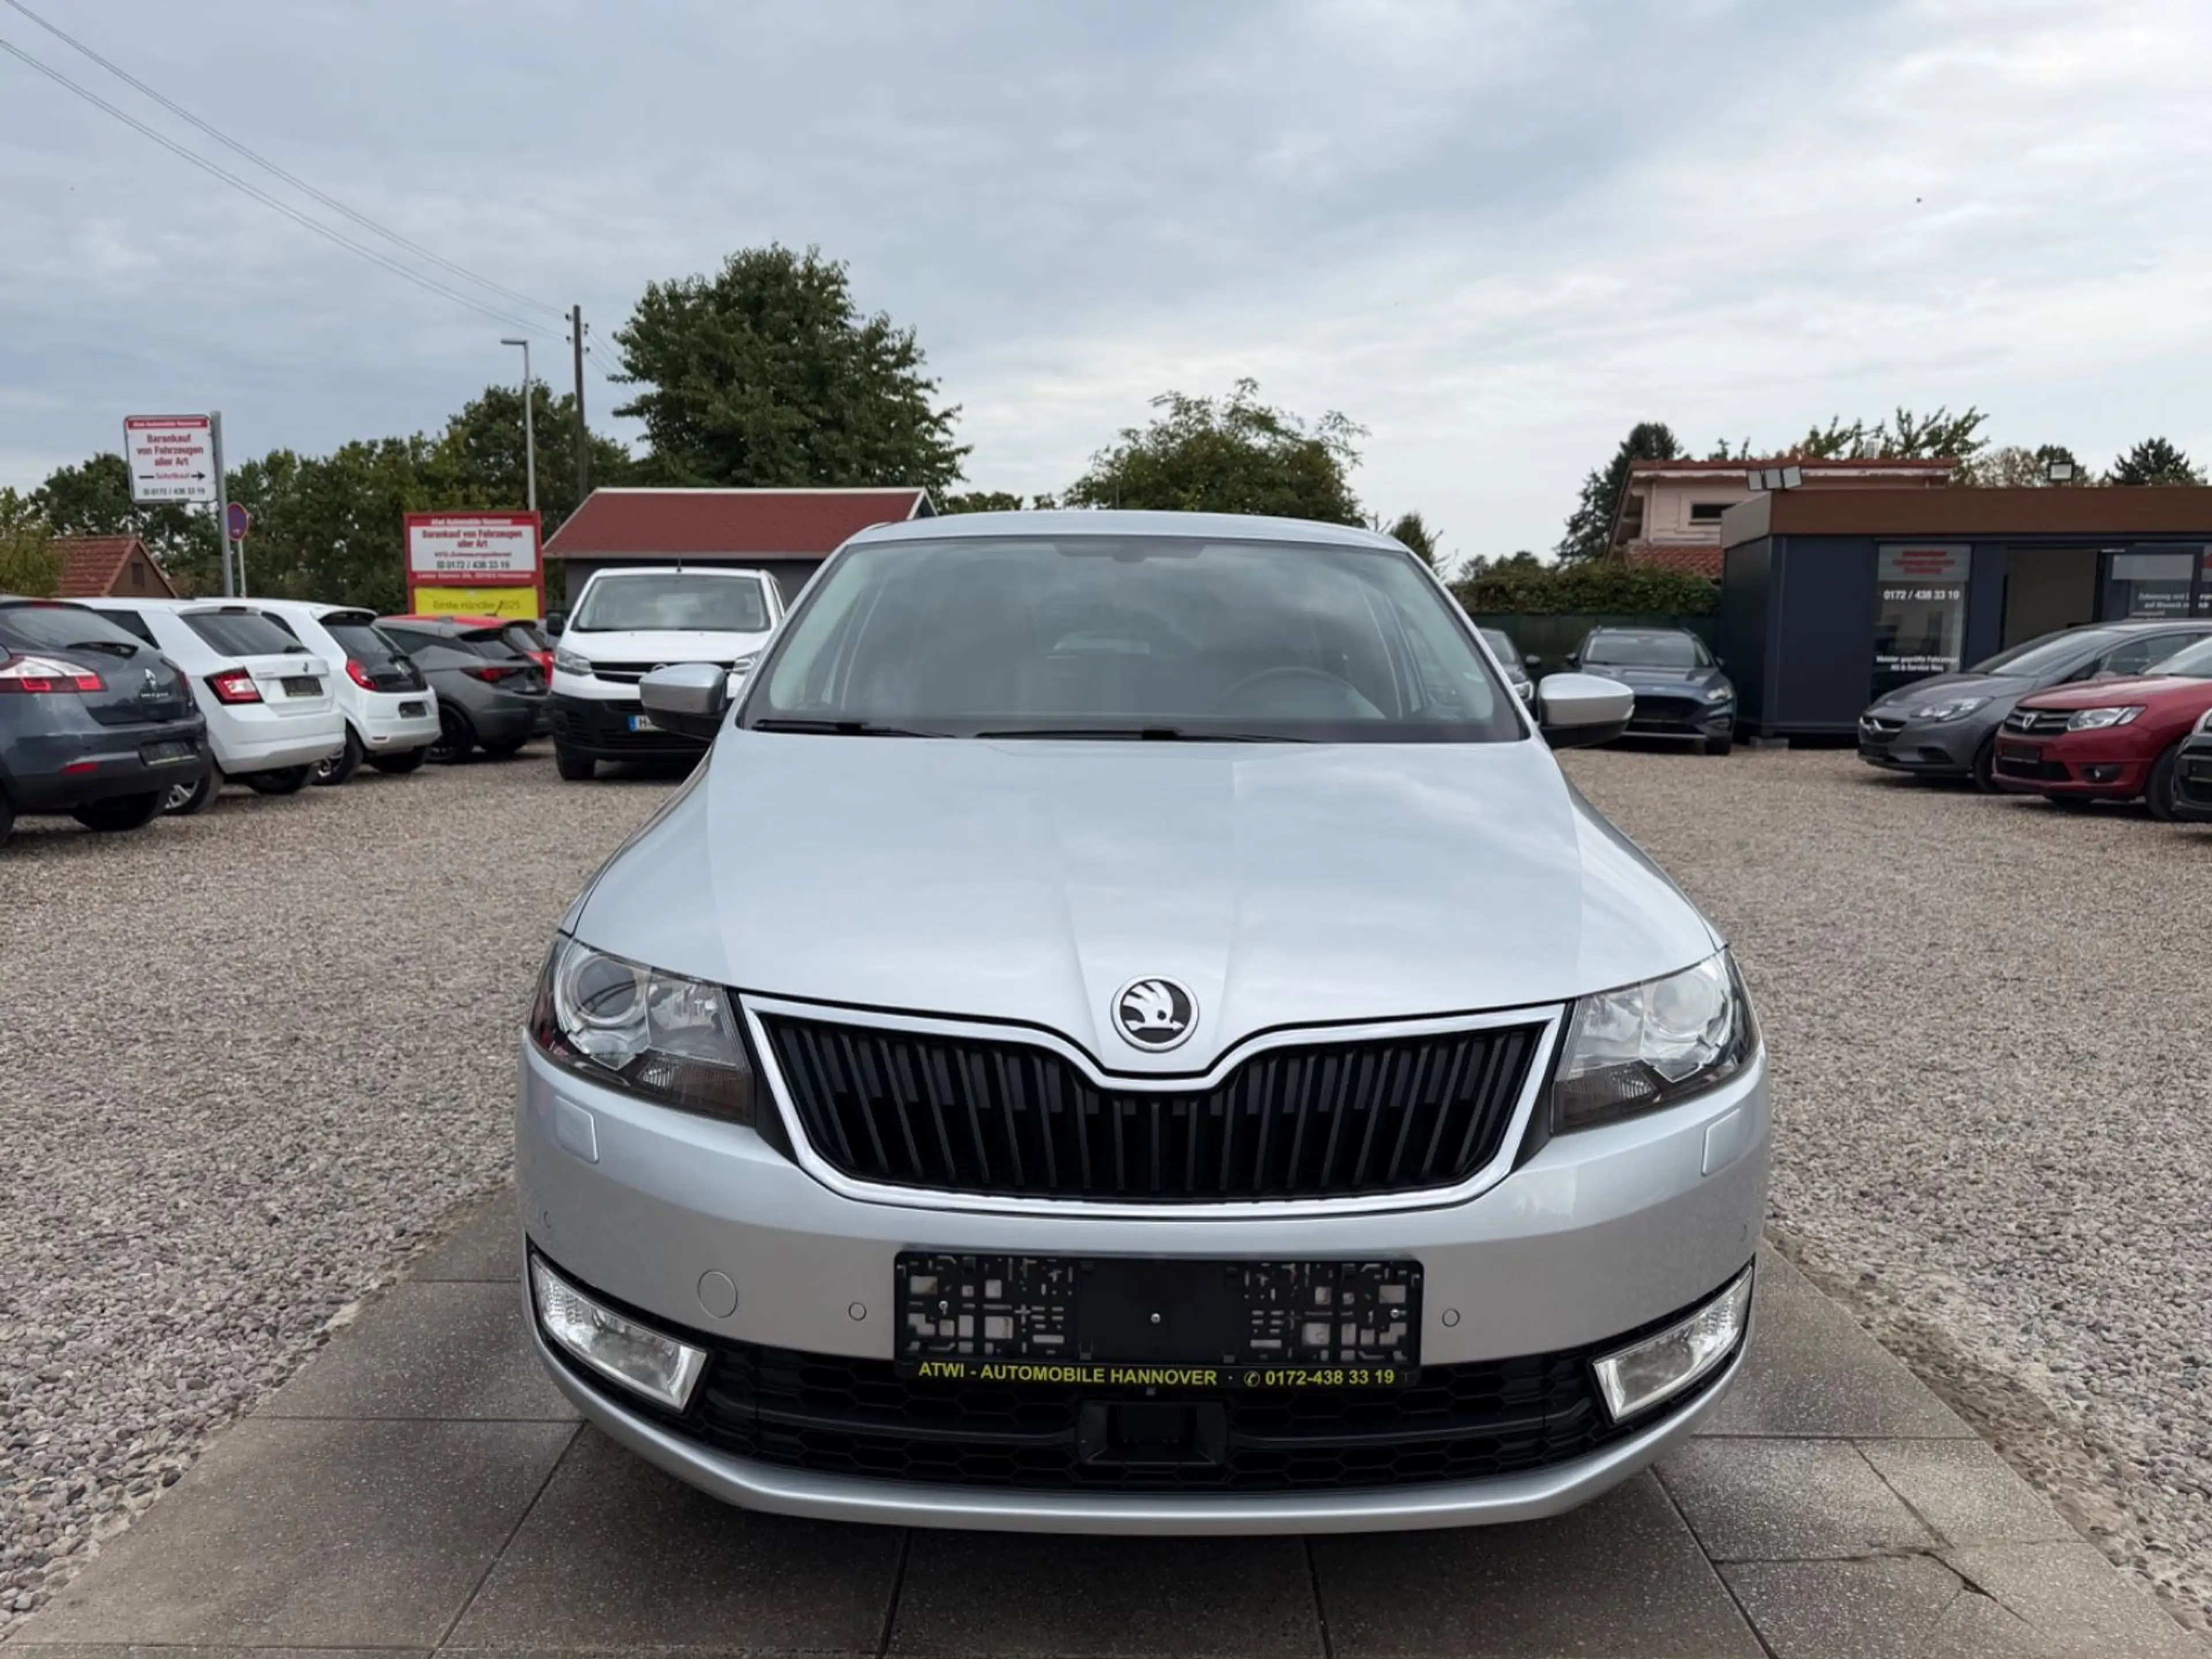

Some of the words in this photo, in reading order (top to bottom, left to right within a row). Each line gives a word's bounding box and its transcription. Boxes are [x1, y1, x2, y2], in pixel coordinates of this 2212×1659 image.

[1884, 589, 1907, 600] 0172
[918, 1362, 964, 1377] ATWI
[980, 1364, 1105, 1382] AUTOMOBILE
[1111, 1369, 1217, 1385] HANNOVER
[1266, 1370, 1343, 1385] 0172-438
[1349, 1370, 1369, 1384] 33
[1375, 1369, 1394, 1384] 19
